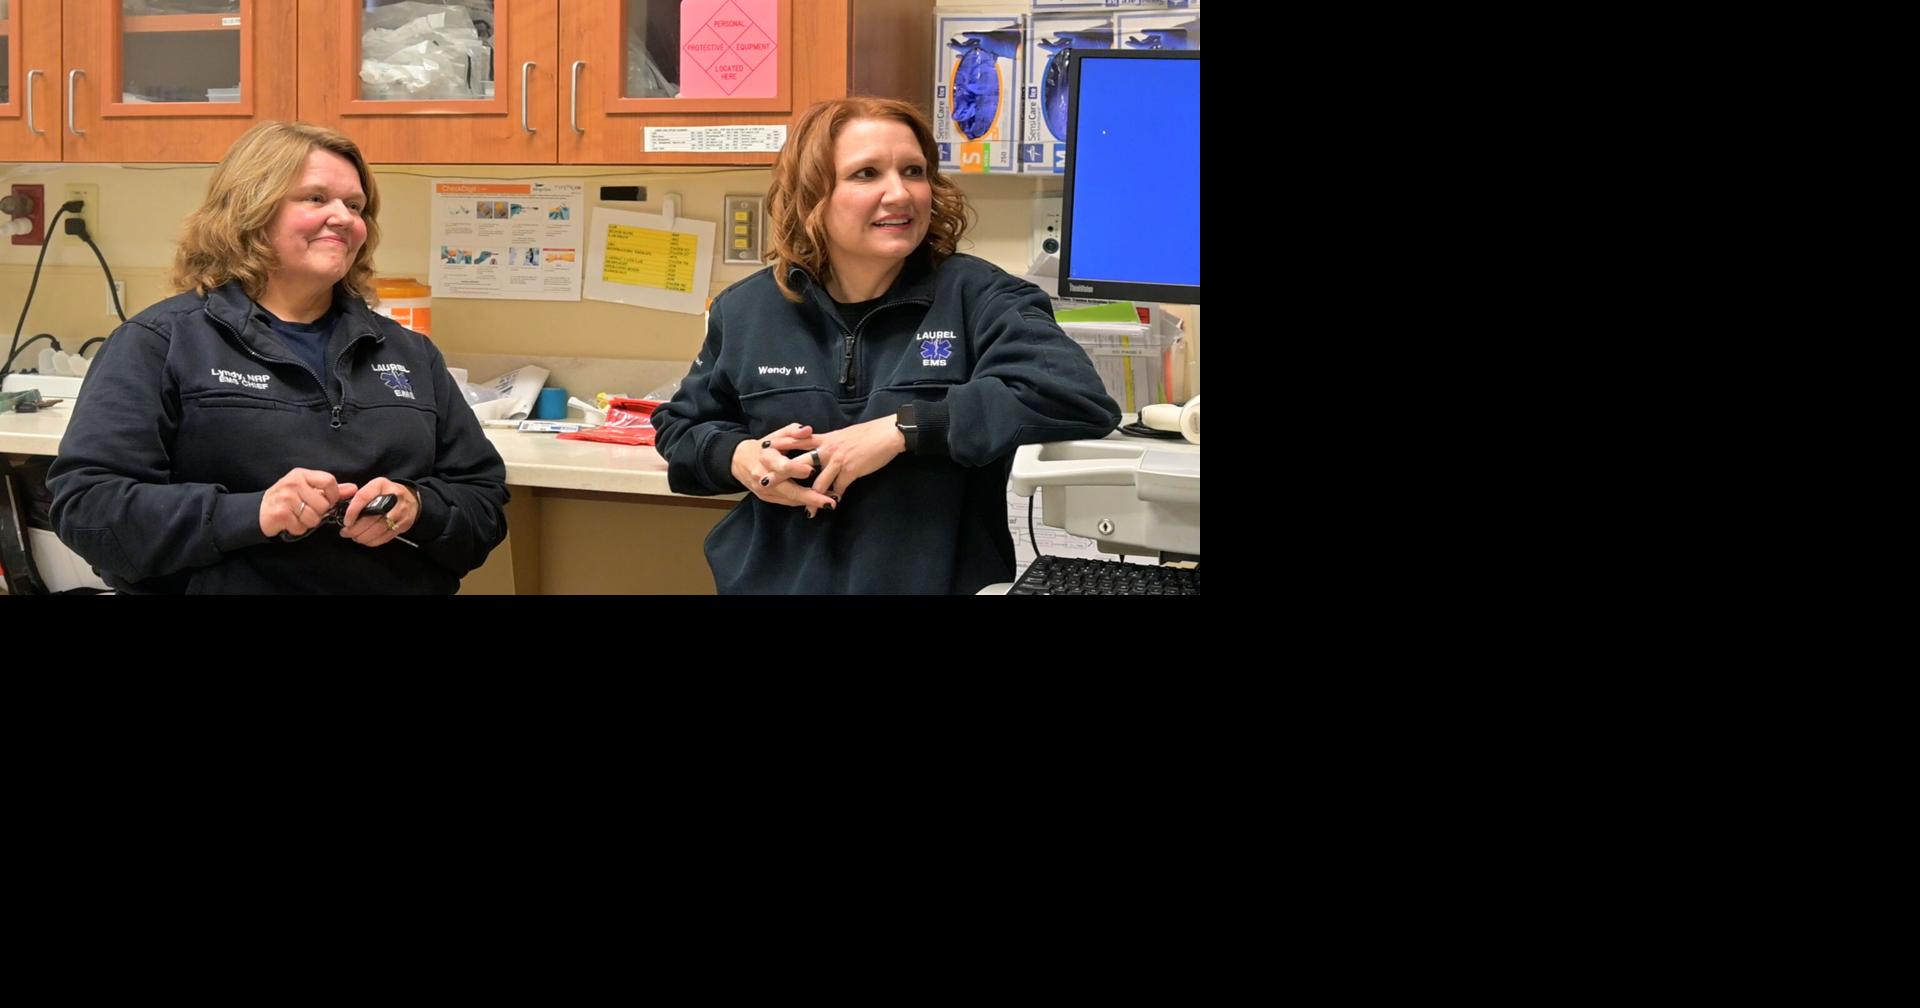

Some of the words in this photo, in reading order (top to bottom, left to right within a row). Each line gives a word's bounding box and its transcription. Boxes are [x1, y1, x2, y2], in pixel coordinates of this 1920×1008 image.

[687, 43, 724, 51] PROTECTIVE
[735, 43, 770, 51] EQUIPMENT
[715, 64, 744, 72] LOCATED
[1029, 88, 1037, 98] Ice
[936, 101, 945, 140] SensiCare
[1028, 101, 1037, 141] SensiCare
[962, 151, 981, 165] S
[917, 331, 956, 340] LAUREL
[371, 363, 410, 373] LAUREL
[758, 366, 791, 375] Wendy
[795, 366, 807, 374] W.
[247, 374, 270, 382] NRP
[219, 376, 239, 385] EMS
[241, 380, 269, 390] CHIEF
